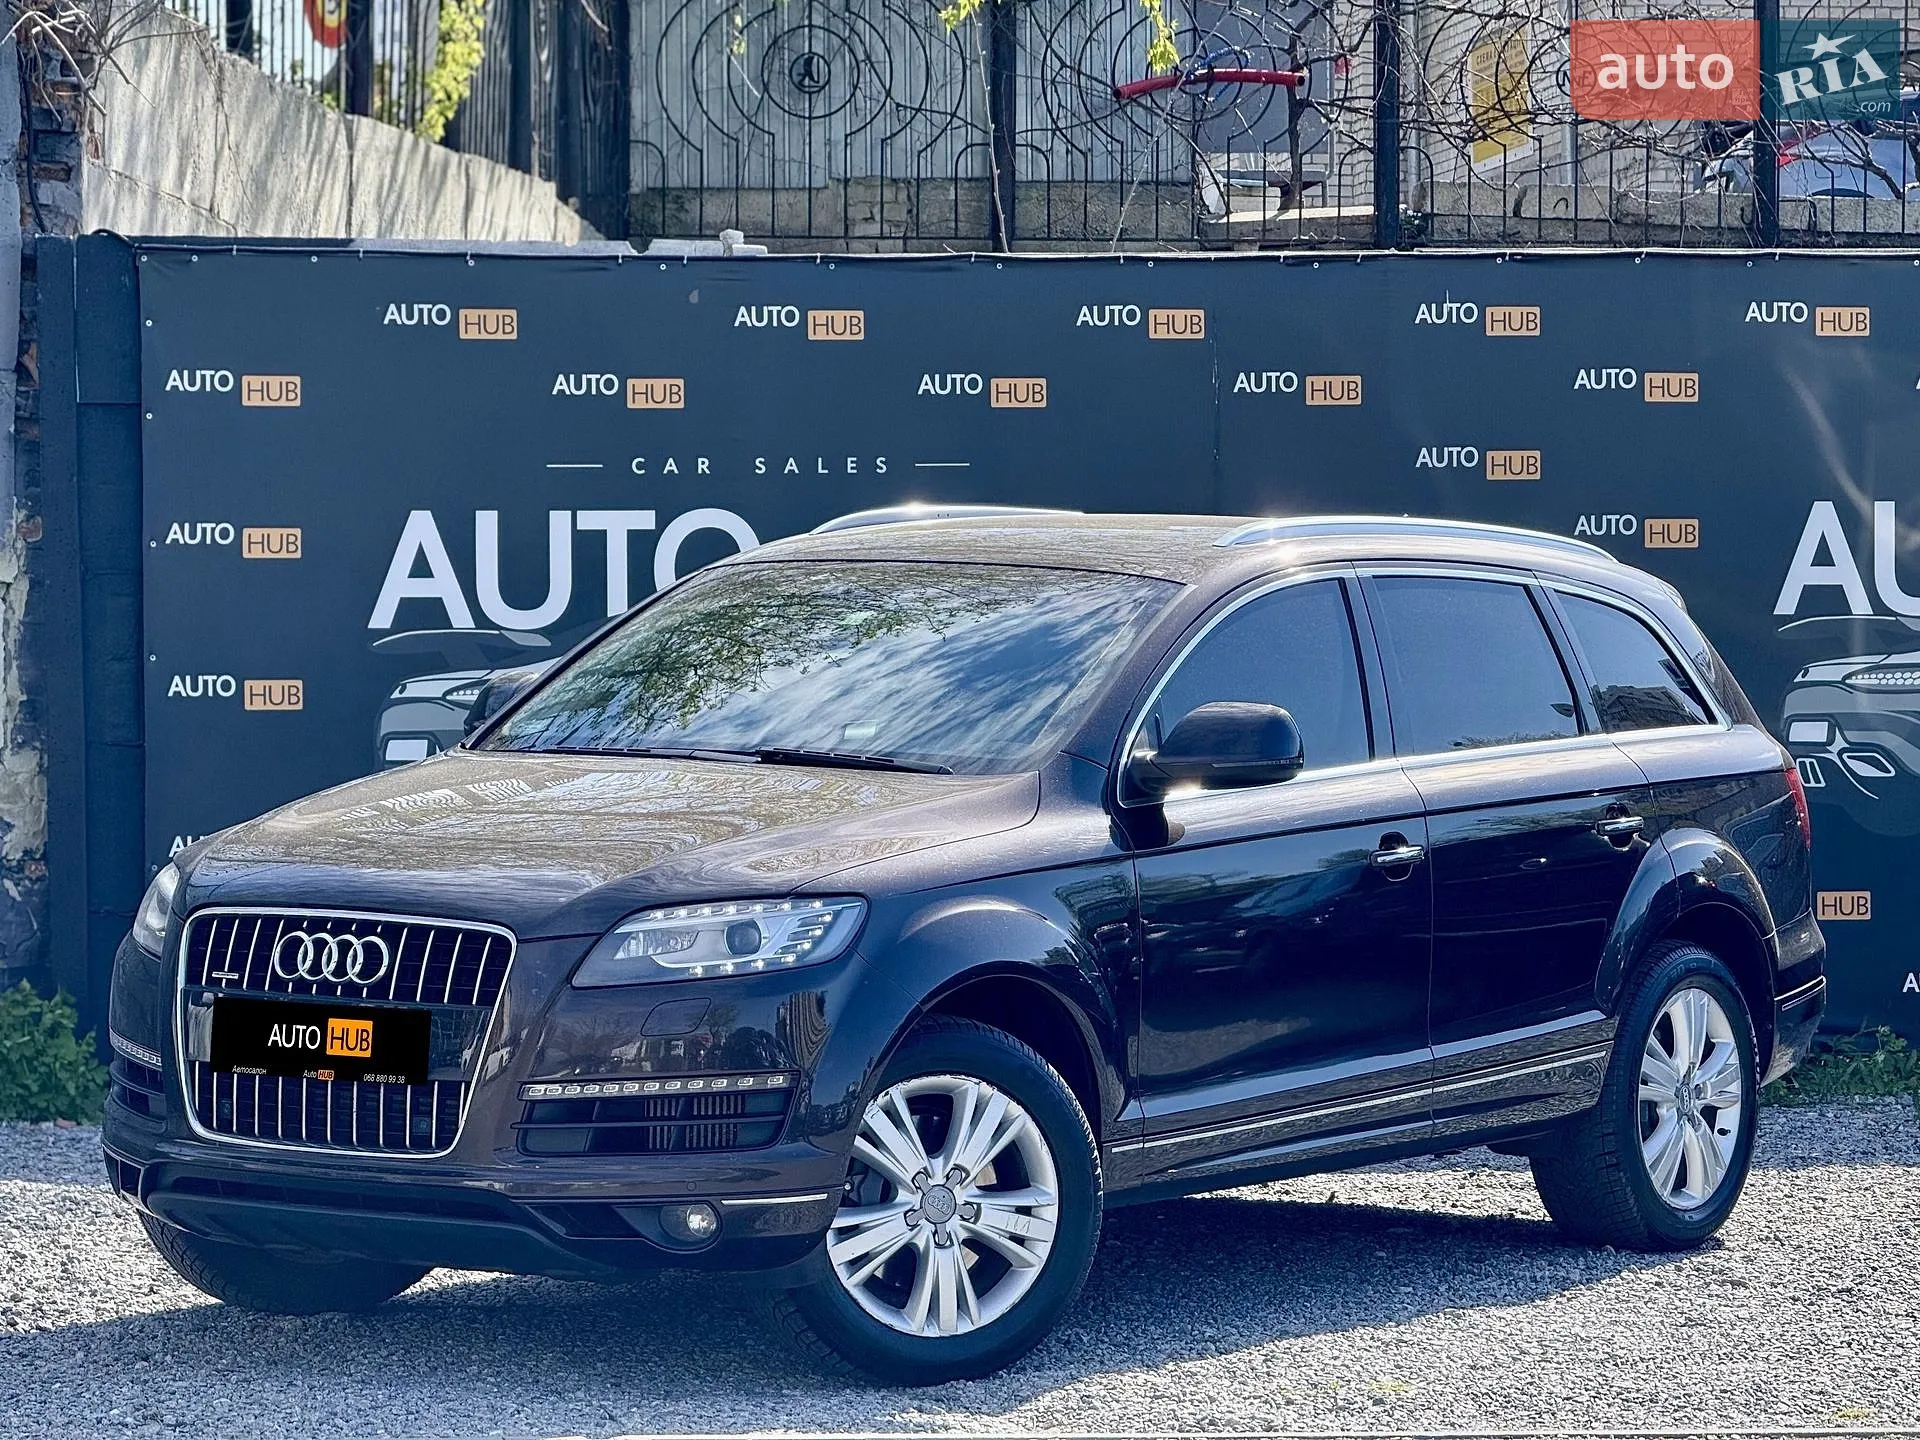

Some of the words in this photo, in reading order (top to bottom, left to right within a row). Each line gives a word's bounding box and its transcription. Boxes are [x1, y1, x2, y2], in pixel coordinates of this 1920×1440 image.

[384, 304, 451, 325] AUTO
[464, 314, 515, 335] HUB
[734, 306, 799, 326] AUTO
[812, 315, 862, 335] HUB
[1077, 305, 1140, 326] AUTO
[1153, 315, 1203, 334] HUB
[1415, 303, 1478, 323] AUTO
[1490, 312, 1538, 331] HUB
[1745, 302, 1808, 322] AUTO
[1820, 312, 1867, 332] HUB
[166, 370, 233, 391] AUTO
[247, 381, 298, 401] HUB
[552, 374, 618, 395] AUTO
[632, 384, 682, 404] HUB
[918, 374, 982, 394] AUTO
[995, 382, 1044, 403] HUB
[1234, 372, 1297, 392] AUTO
[1311, 381, 1359, 400] HUB
[1574, 369, 1636, 389] AUTO
[1649, 378, 1696, 398] HUB
[632, 458, 711, 474] CAR
[756, 457, 886, 473] SALES
[1416, 447, 1478, 467] AUTO
[1491, 456, 1538, 475] HUB
[166, 523, 234, 544] AUTO
[247, 533, 298, 553] HUB
[1575, 515, 1636, 535] AUTO
[1649, 523, 1696, 543] HUB
[168, 675, 235, 696] AUTO
[249, 685, 300, 705] HUB
[1822, 896, 1869, 916] HUB
